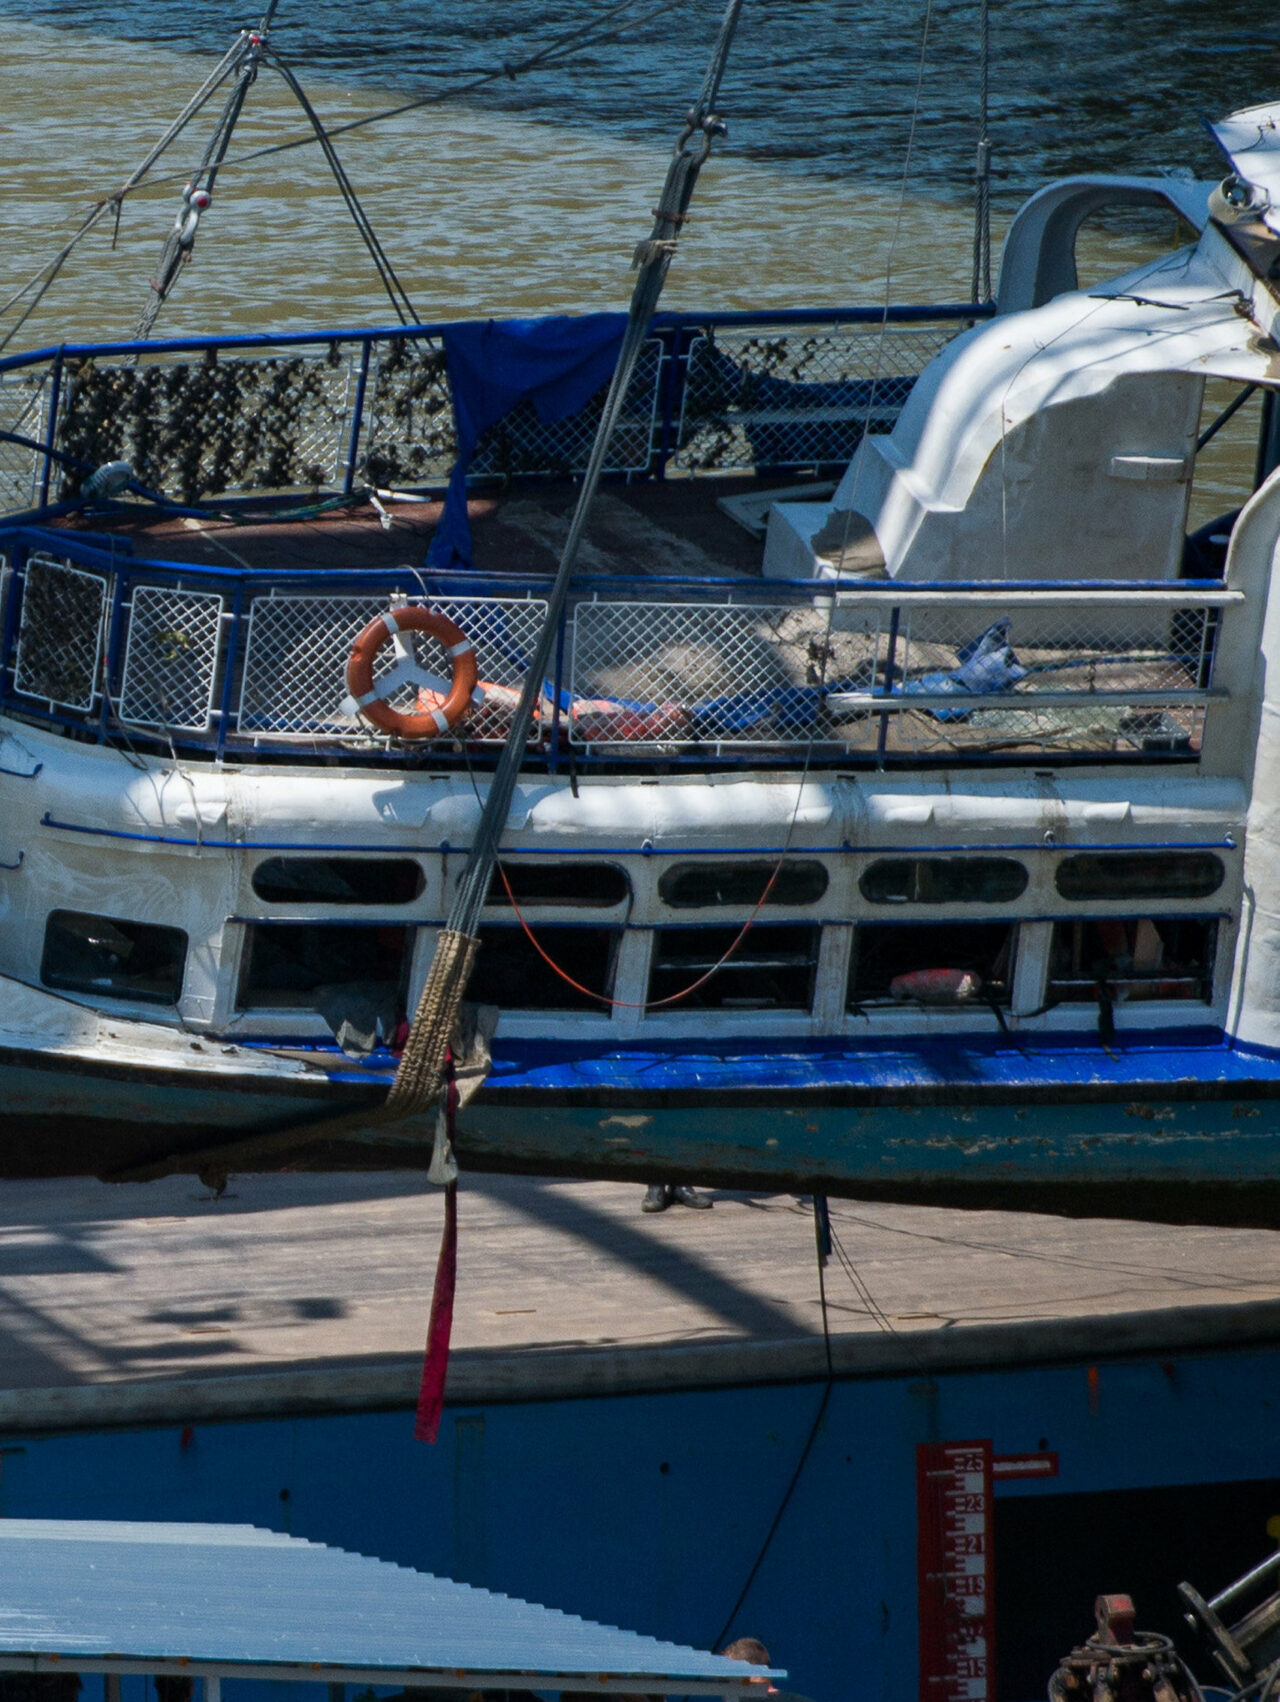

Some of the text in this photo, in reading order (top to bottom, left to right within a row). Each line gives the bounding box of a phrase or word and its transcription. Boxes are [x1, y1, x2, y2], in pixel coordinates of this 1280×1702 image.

[966, 1453, 985, 1470] 25
[966, 1494, 985, 1512] 23
[967, 1535, 985, 1553] 21
[967, 1576, 985, 1593] 19
[969, 1658, 986, 1676] 15
